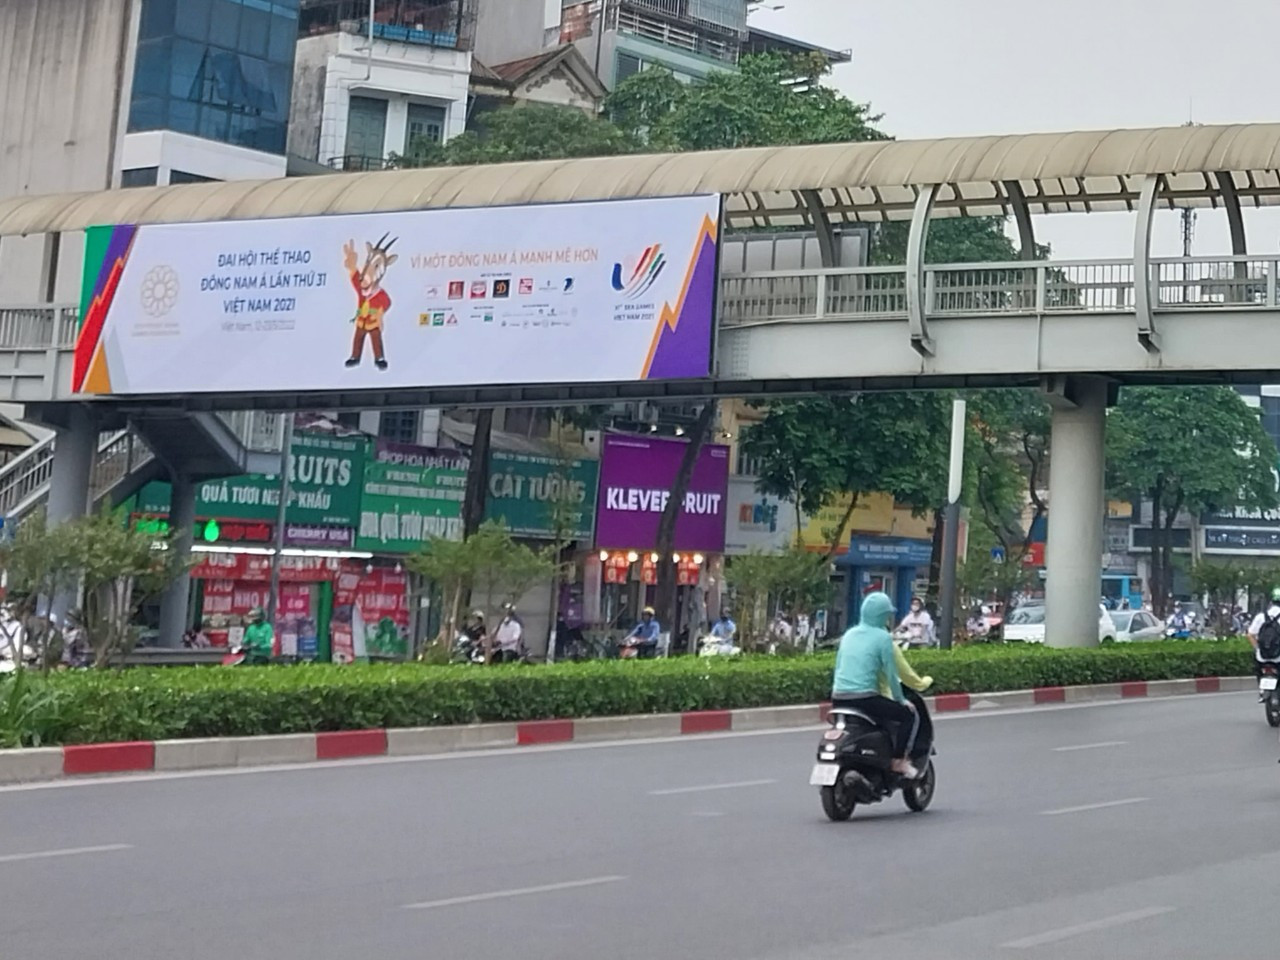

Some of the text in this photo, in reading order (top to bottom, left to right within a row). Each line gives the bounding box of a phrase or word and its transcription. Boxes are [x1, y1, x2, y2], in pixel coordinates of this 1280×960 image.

[238, 250, 258, 267] HỘI
[282, 250, 312, 264] THAO
[449, 250, 480, 268] ĐÔNG
[482, 251, 507, 267] NAM
[200, 274, 231, 292] ĐÔNG
[234, 277, 258, 290] NAM
[259, 272, 268, 289] Á
[317, 272, 327, 287] 31
[247, 298, 272, 313] NAM
[274, 297, 296, 312] 2021
[264, 454, 352, 487] RUITS
[682, 492, 721, 515] RUIT
[288, 528, 350, 540] CHERRY USA
